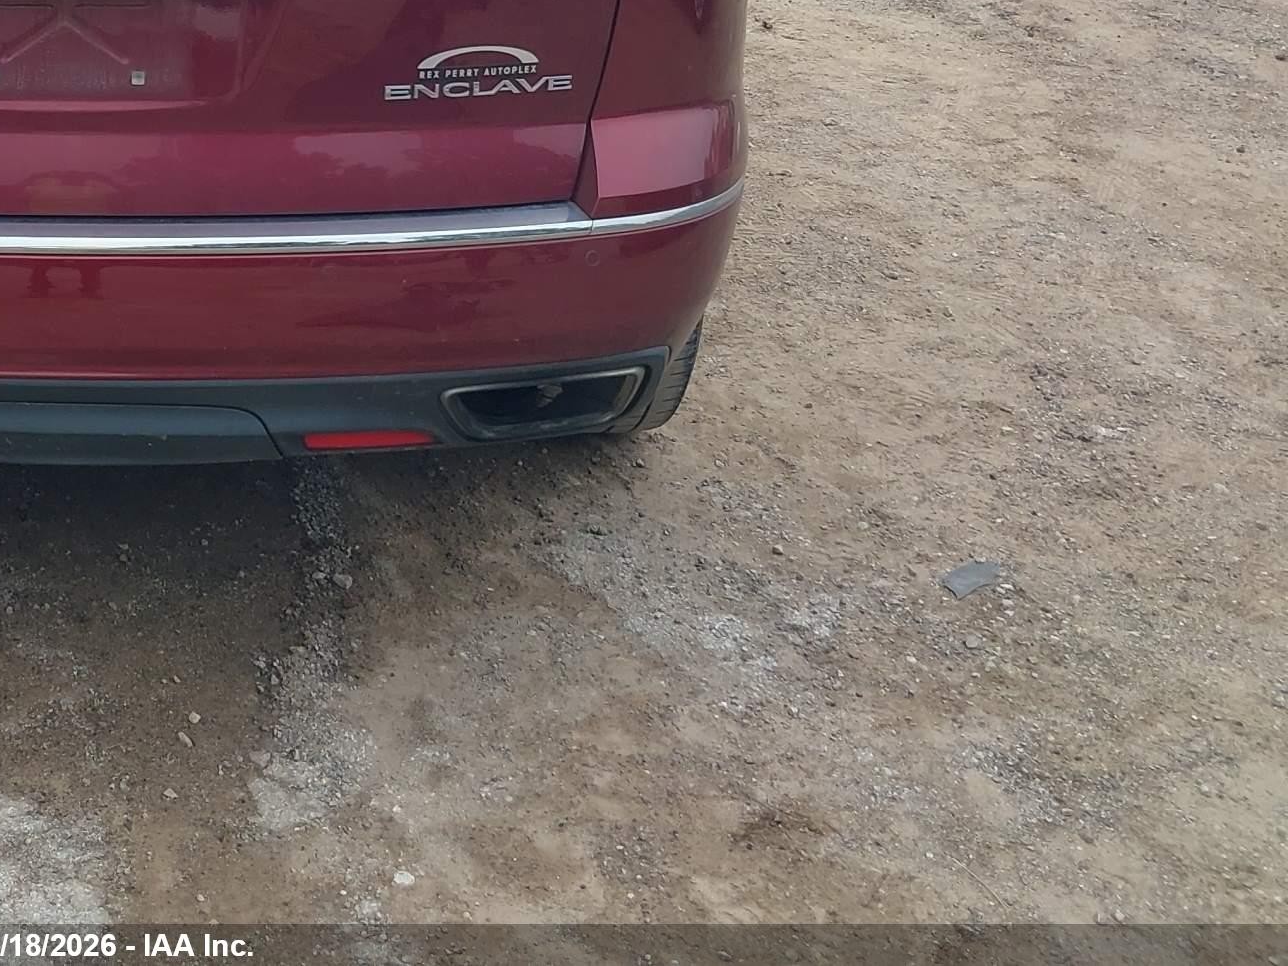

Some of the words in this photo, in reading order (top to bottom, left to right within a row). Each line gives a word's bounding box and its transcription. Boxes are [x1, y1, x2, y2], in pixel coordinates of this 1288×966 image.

[419, 70, 440, 79] REX
[445, 68, 479, 78] PERRY
[483, 64, 537, 76] AUTOPLEX
[384, 75, 573, 101] ENCLAVE
